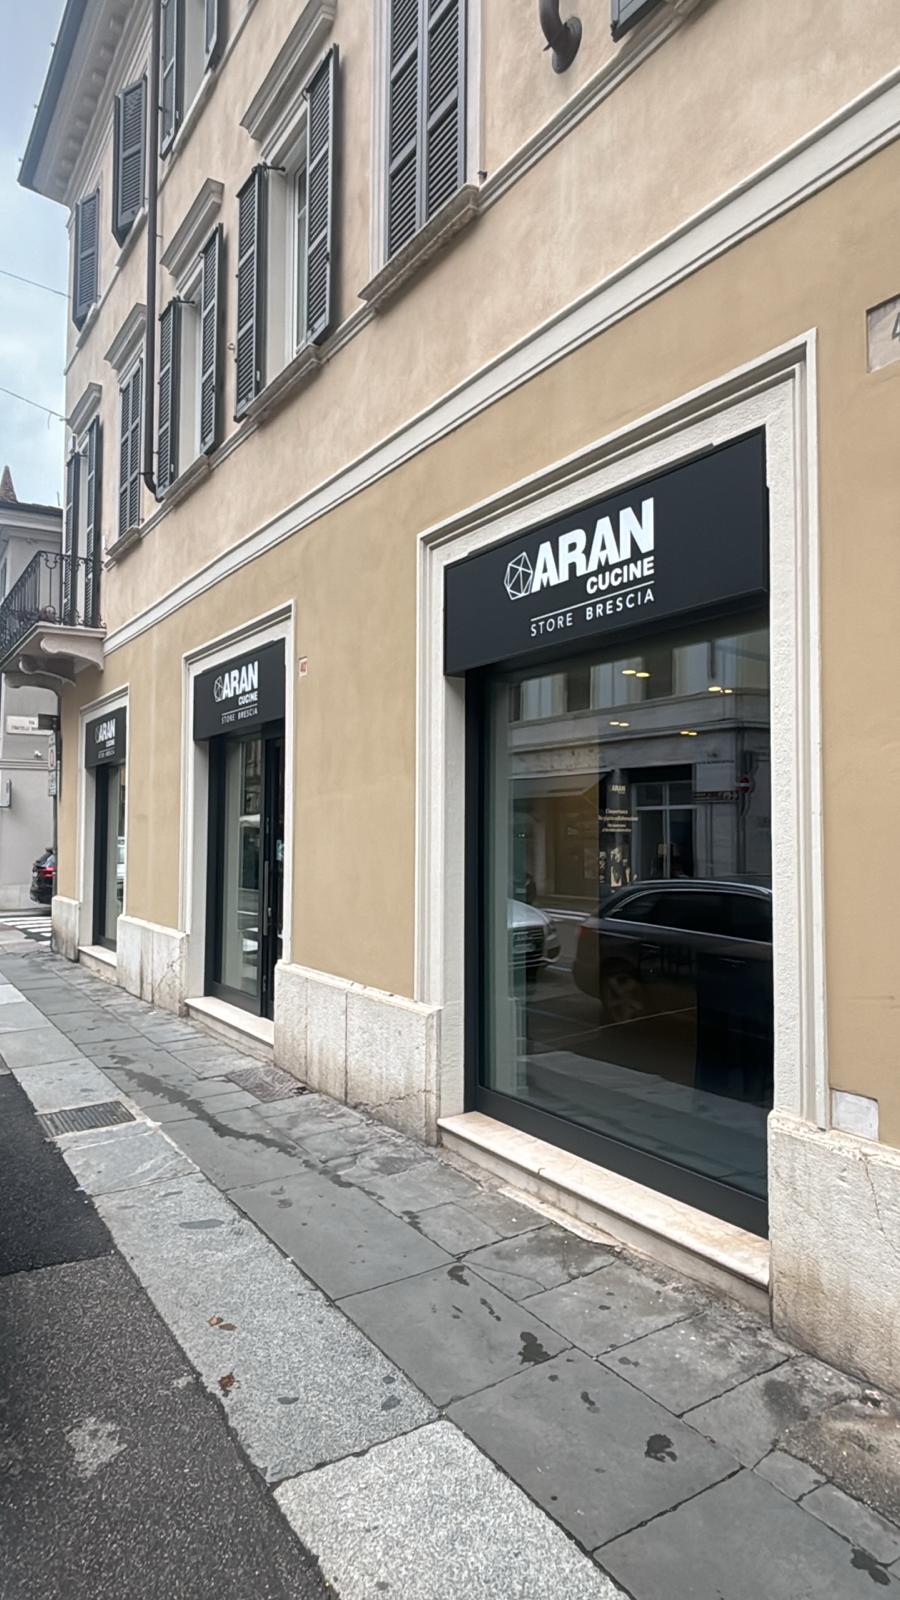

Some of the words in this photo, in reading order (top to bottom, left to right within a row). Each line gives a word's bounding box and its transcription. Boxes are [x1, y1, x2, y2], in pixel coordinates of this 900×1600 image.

[530, 497, 655, 594] ARAN
[586, 556, 655, 594] CUCINE
[530, 612, 574, 637] STORE
[585, 588, 655, 620] BRESCIA
[222, 661, 258, 700] ARAN
